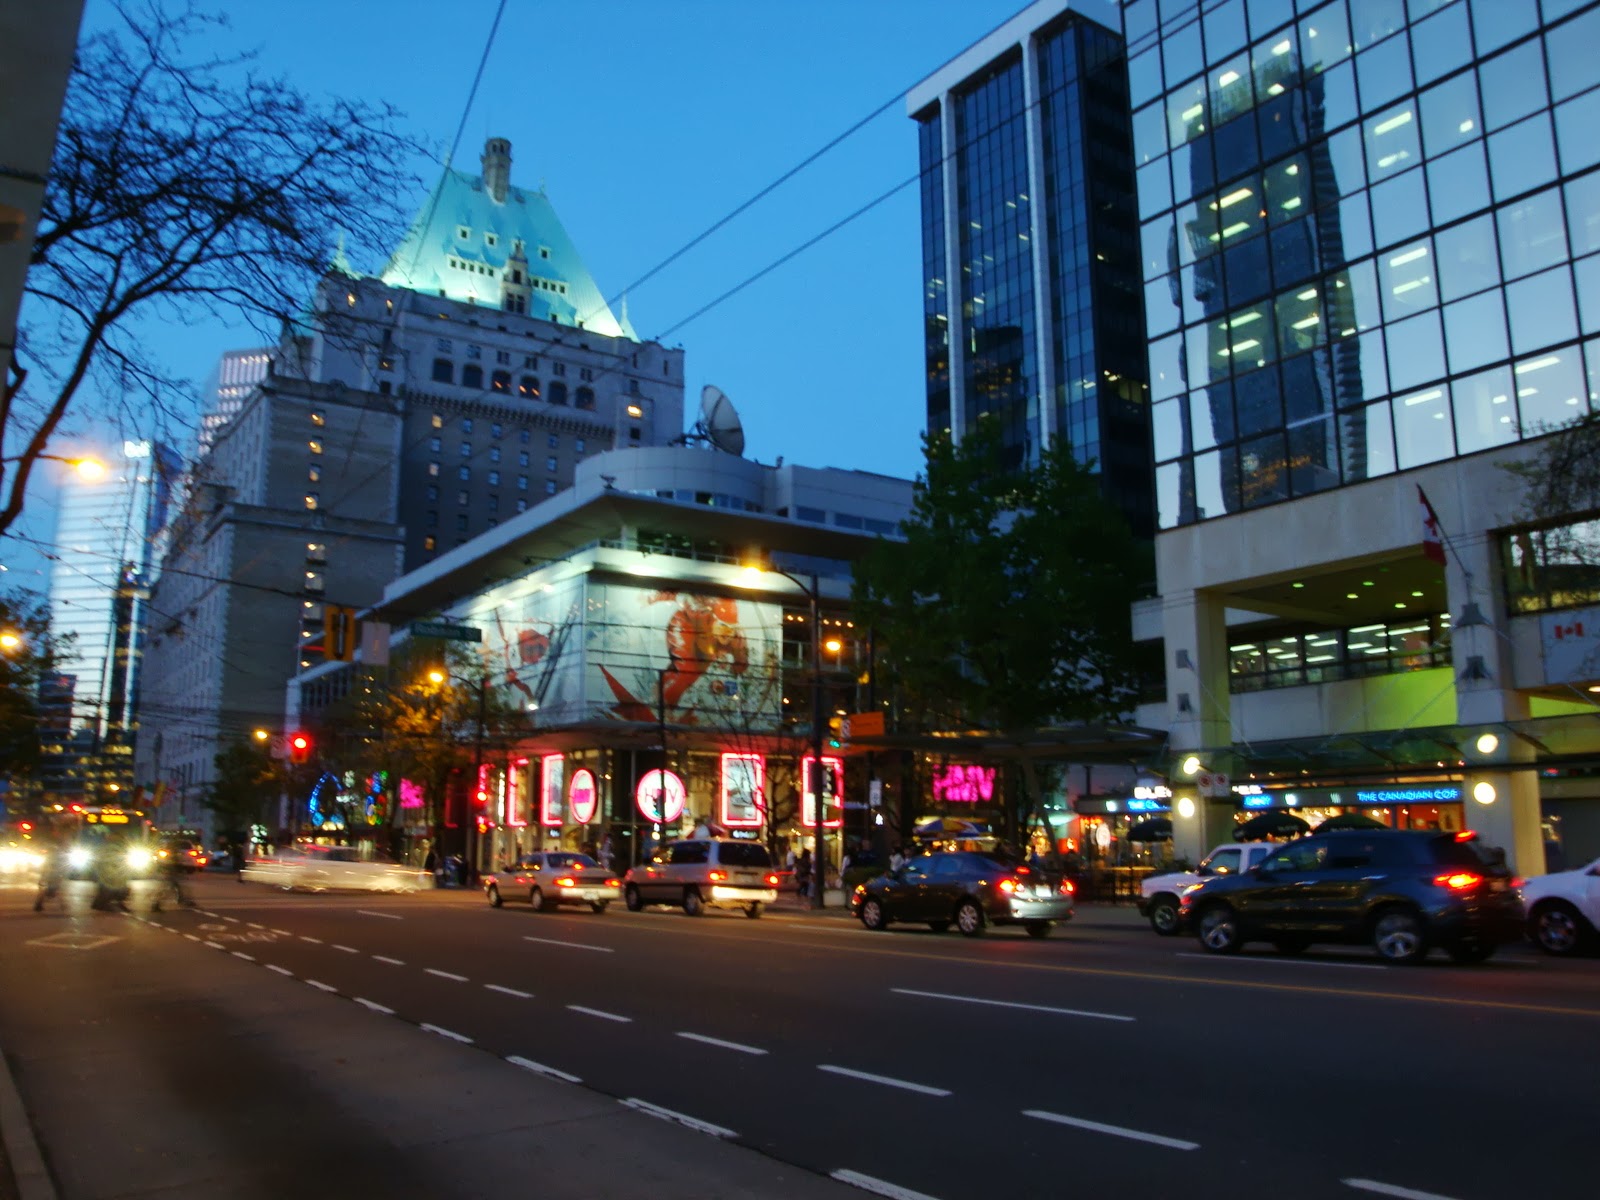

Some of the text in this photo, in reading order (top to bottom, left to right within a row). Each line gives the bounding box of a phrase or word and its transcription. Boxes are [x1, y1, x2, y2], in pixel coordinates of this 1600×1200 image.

[933, 765, 996, 802] HMV
[643, 787, 678, 804] HV
[1356, 791, 1378, 802] THE
[1378, 788, 1433, 802] CANADIAN
